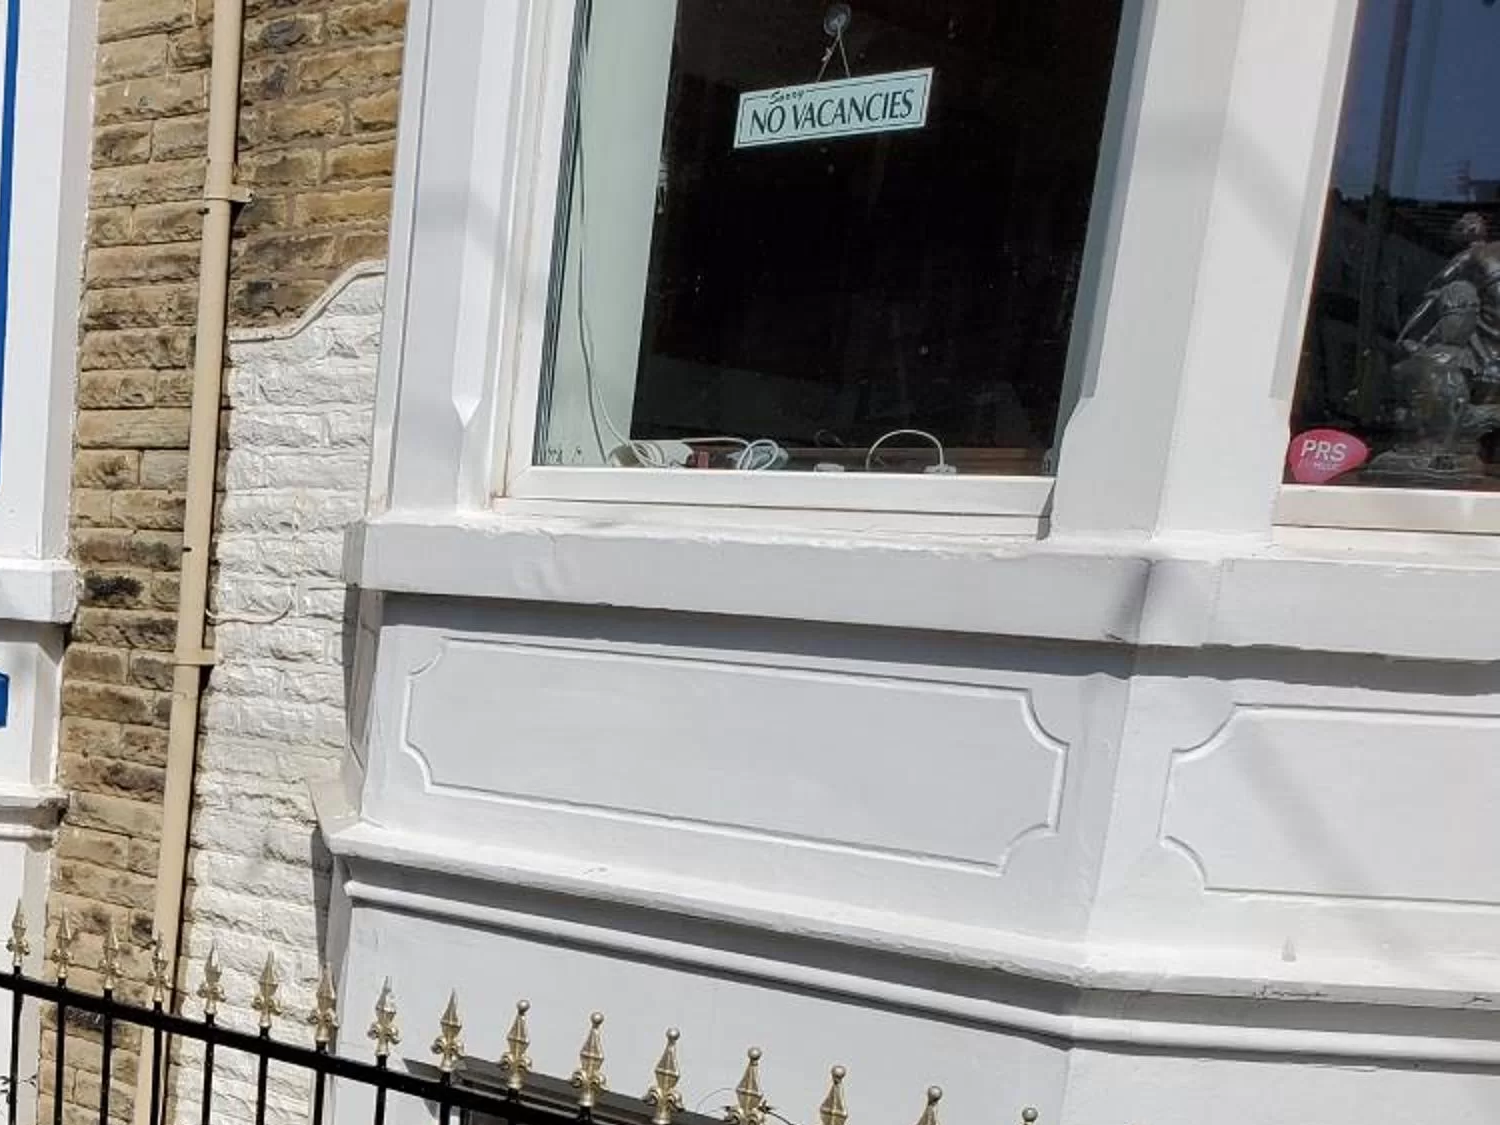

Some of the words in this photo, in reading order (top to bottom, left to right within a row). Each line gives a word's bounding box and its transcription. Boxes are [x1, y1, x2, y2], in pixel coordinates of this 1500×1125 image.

[768, 90, 804, 105] Sorry
[750, 105, 785, 136] NO
[793, 88, 914, 130] VACANCIES
[1300, 438, 1347, 462] PRS
